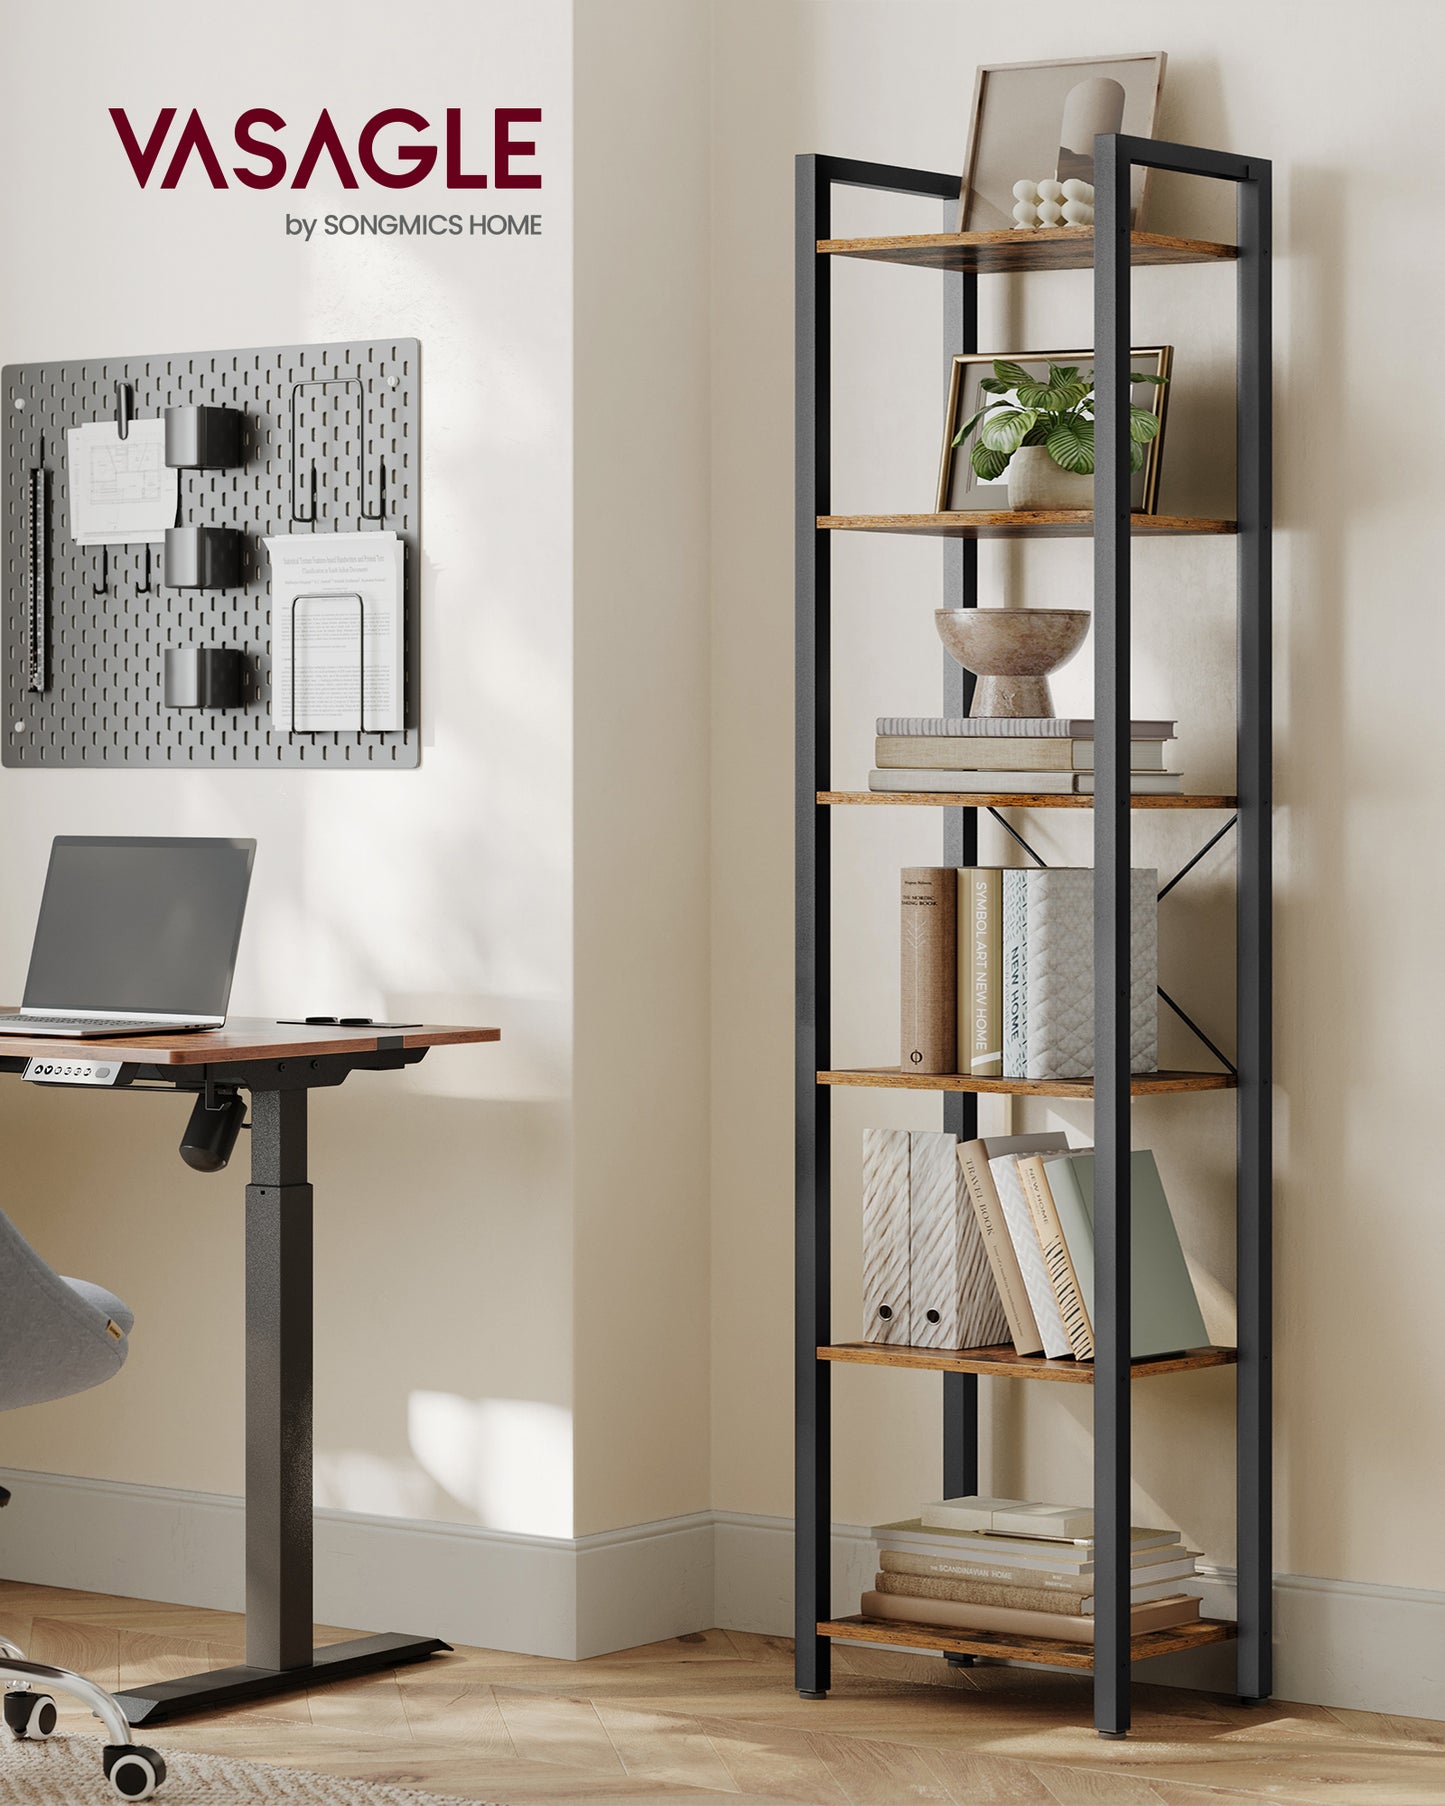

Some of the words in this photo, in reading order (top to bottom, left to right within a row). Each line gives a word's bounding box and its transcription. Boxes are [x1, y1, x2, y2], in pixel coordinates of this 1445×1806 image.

[976, 882, 987, 937] SYMBOL
[976, 941, 987, 968] ART
[1011, 946, 1019, 985] NEW
[976, 972, 987, 1005] NEW
[976, 1008, 987, 1050] HOME
[1011, 990, 1019, 1042] HOME
[966, 1158, 984, 1202] TRAVEL
[979, 1203, 995, 1236] BOOK
[1029, 1168, 1039, 1192] NEW
[1036, 1194, 1049, 1225] HOME
[938, 1565, 989, 1578] SCANDINAVIAN
[991, 1570, 1013, 1580] HOME
